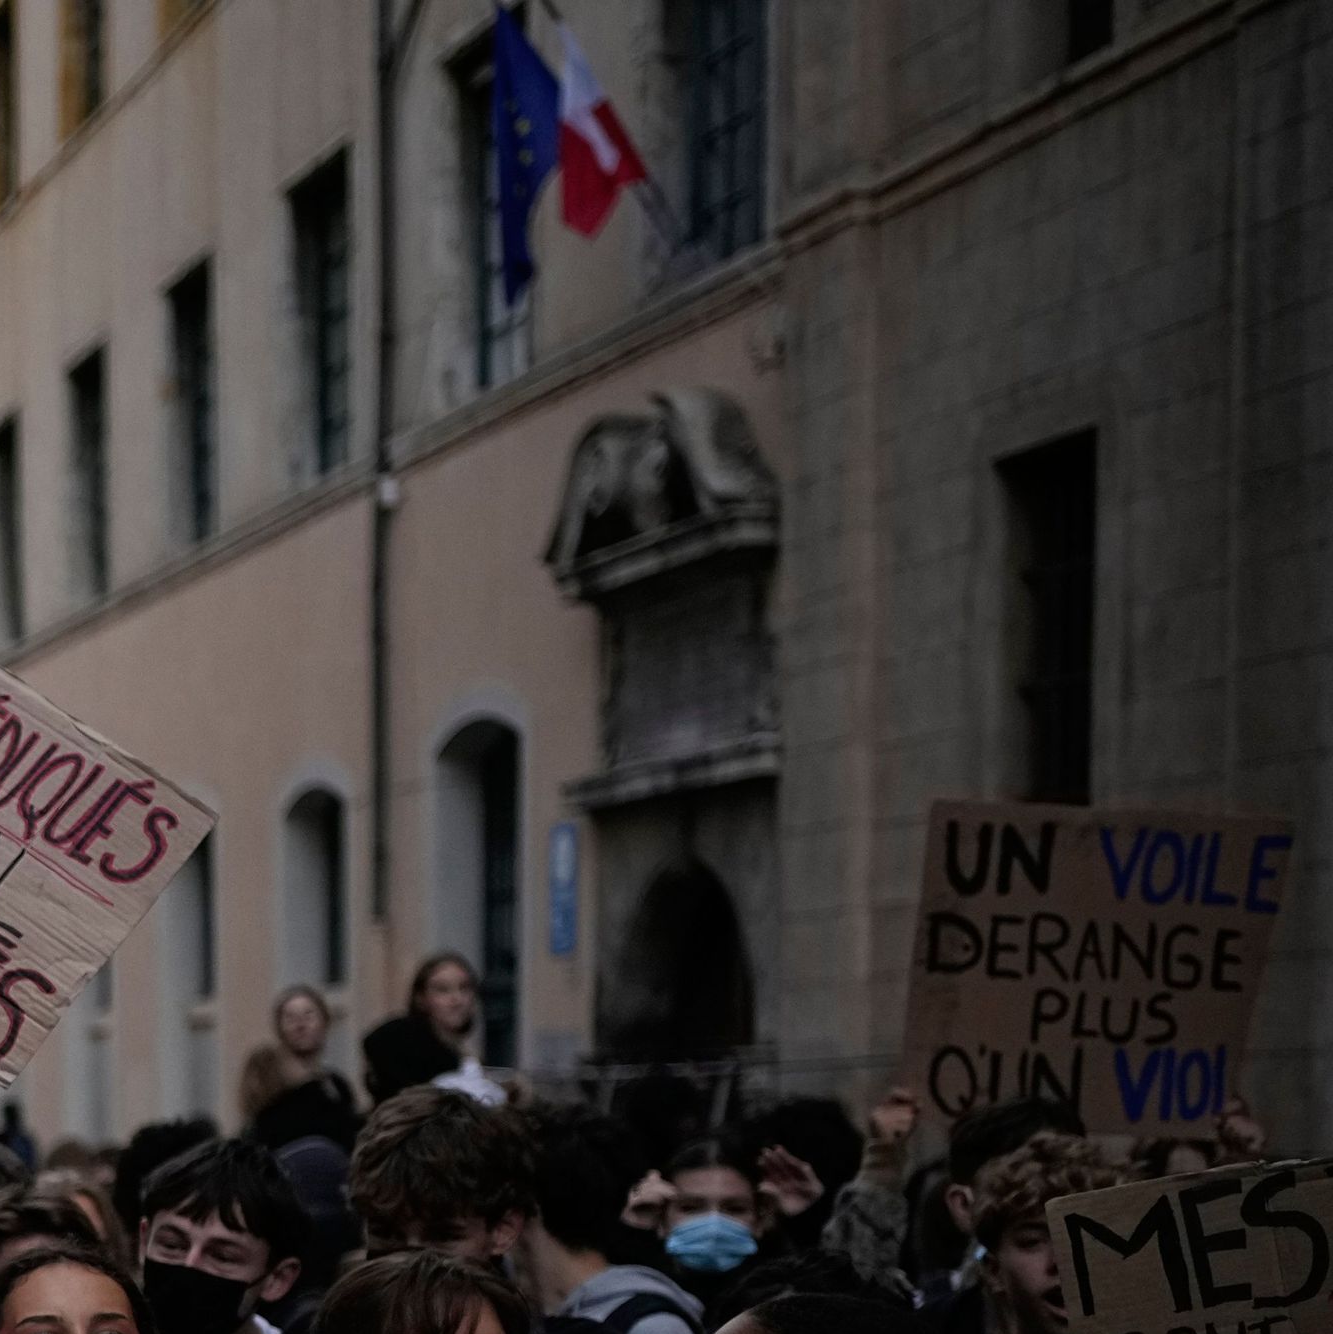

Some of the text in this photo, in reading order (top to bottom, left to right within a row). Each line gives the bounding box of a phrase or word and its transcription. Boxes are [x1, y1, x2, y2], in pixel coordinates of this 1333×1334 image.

[946, 820, 1293, 914] UN VOILE
[927, 912, 1243, 991] DERANGE
[1032, 988, 1178, 1044] PLUS
[1064, 1170, 1329, 1316] MES
